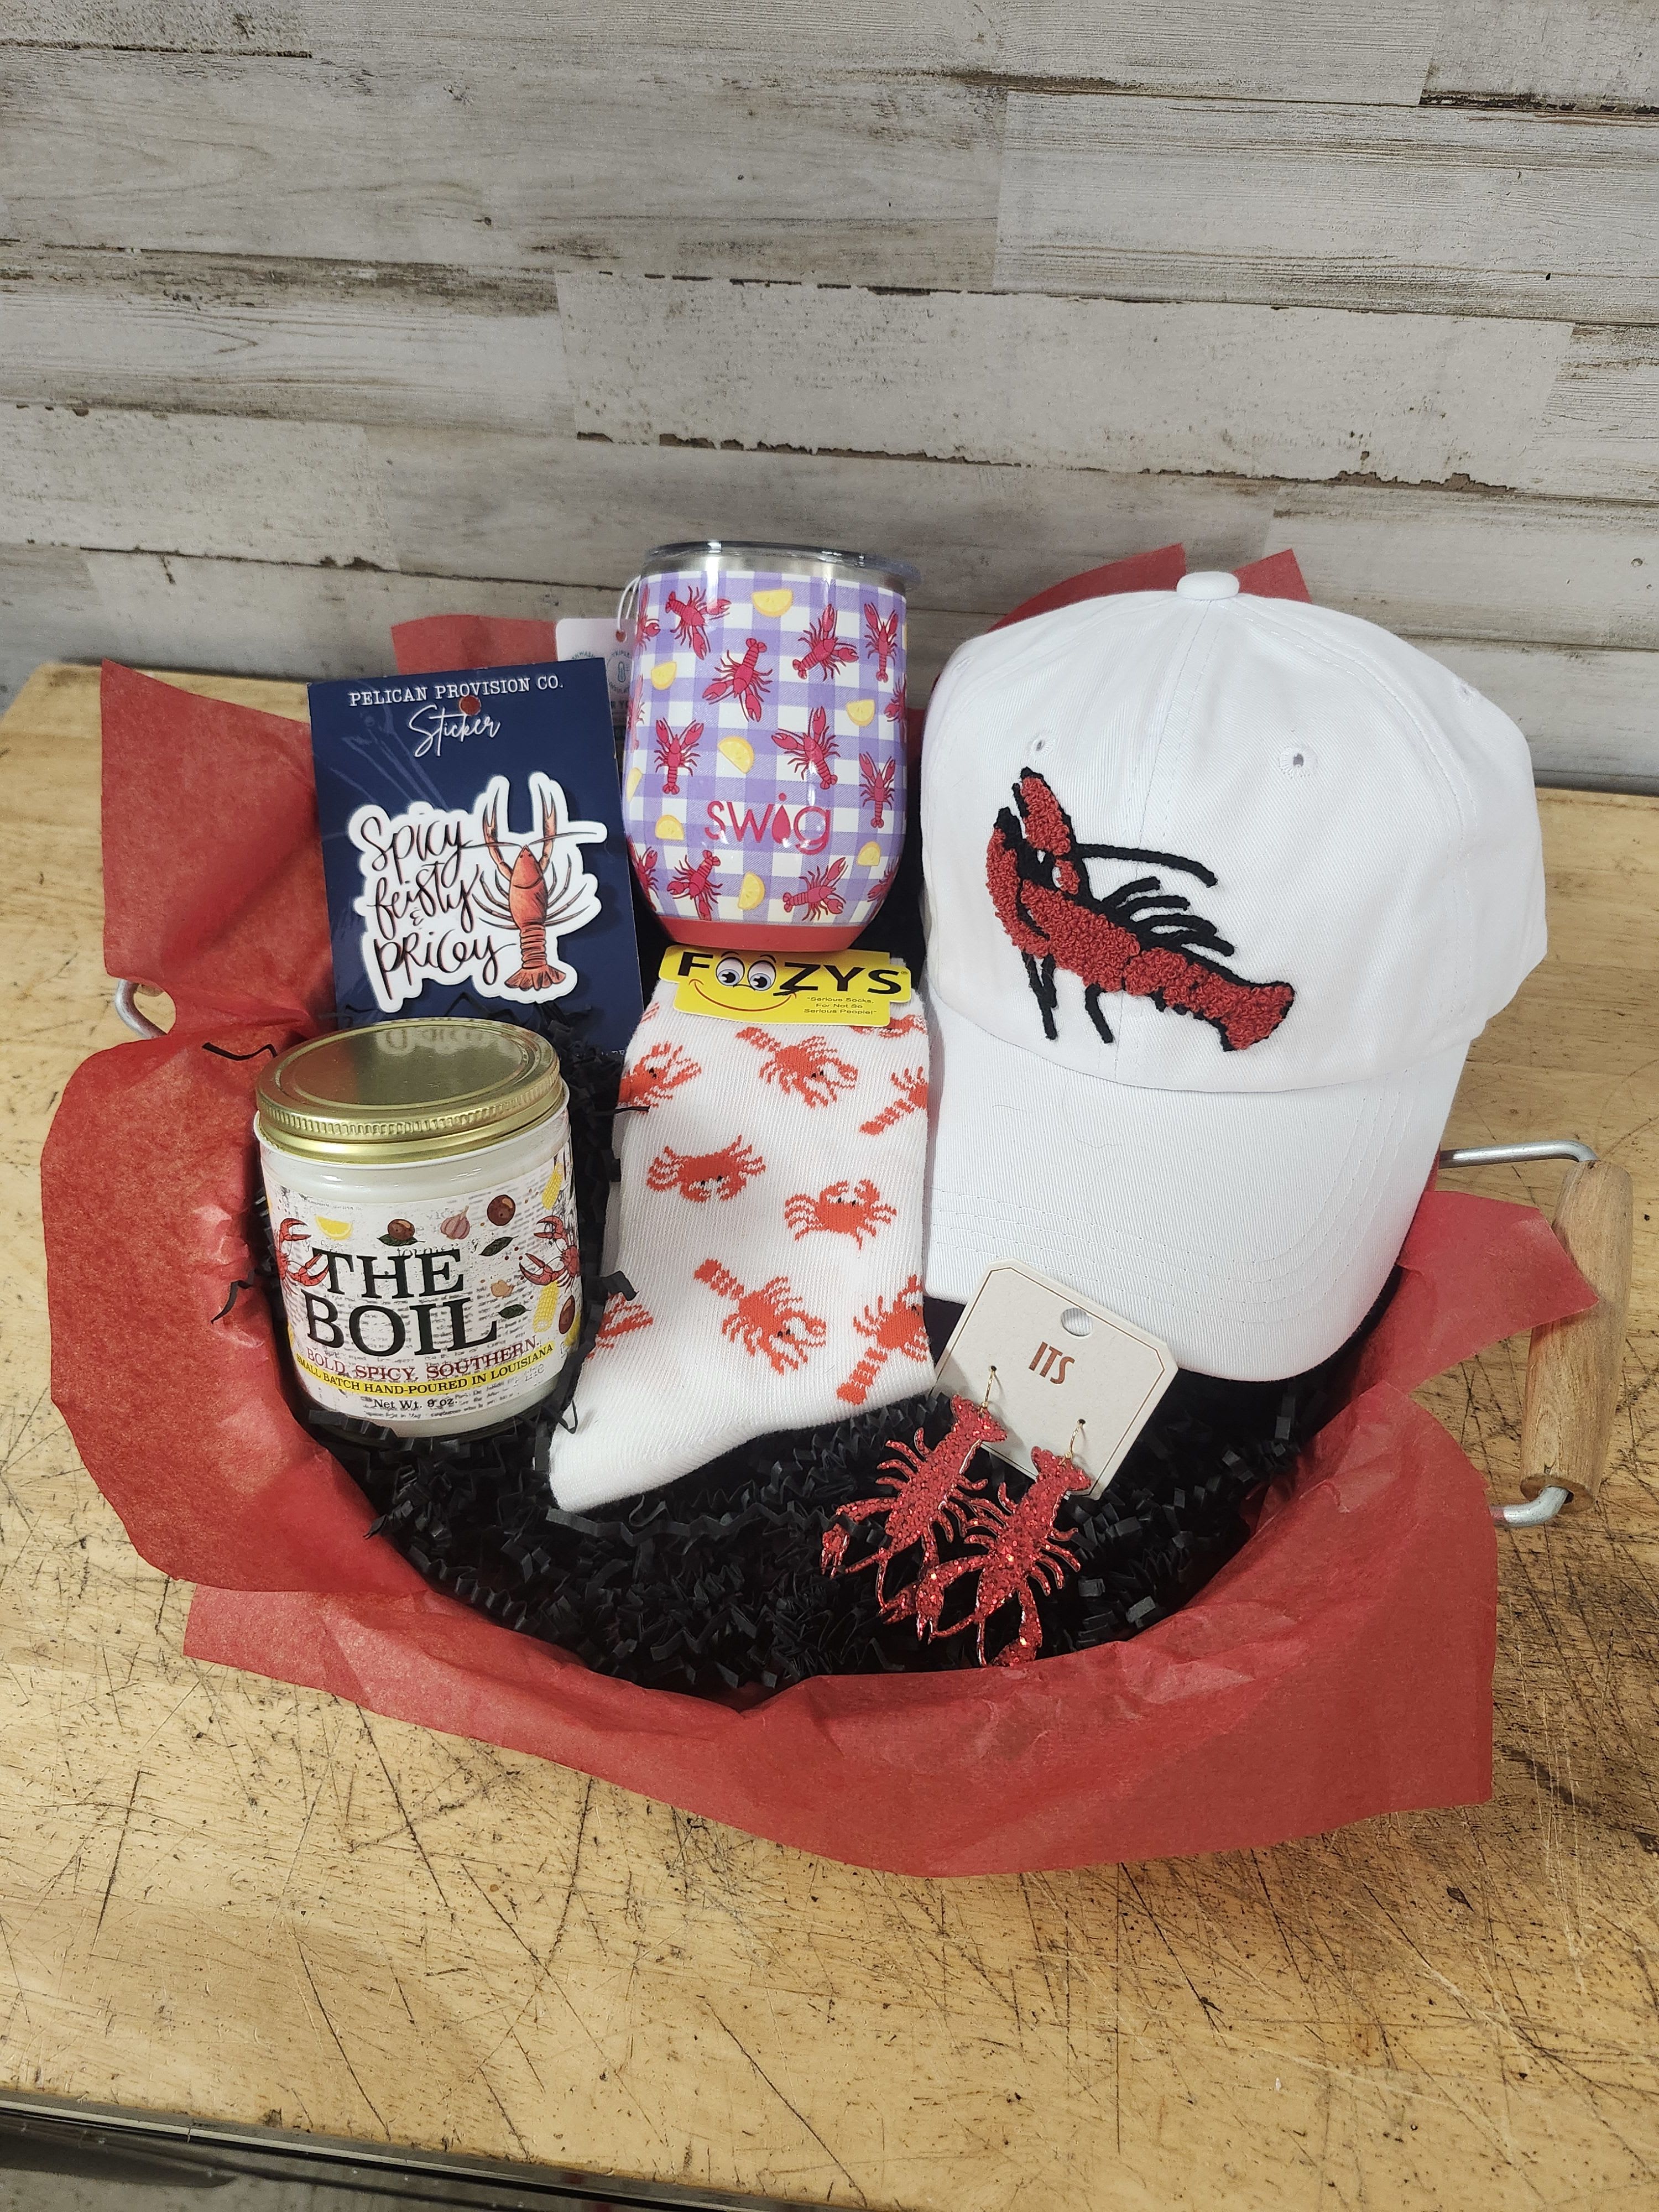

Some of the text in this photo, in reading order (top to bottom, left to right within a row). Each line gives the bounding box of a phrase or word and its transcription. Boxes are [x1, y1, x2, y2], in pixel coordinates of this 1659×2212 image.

[349, 675, 564, 706] PELICAN PROVISION CO.
[408, 705, 502, 758] Sticker
[312, 1246, 464, 1299] THE
[300, 1289, 498, 1357] BOIL
[296, 1353, 321, 1378] SMALL
[324, 1375, 360, 1391] BATCH
[364, 1378, 467, 1394] HAND-POURED
[472, 1373, 486, 1385] IN
[491, 1343, 554, 1380] LOUISIANA
[1028, 1341, 1076, 1385] ITS
[373, 1399, 395, 1409] Net
[399, 1400, 422, 1409] Wt.
[440, 1399, 458, 1407] oz.
